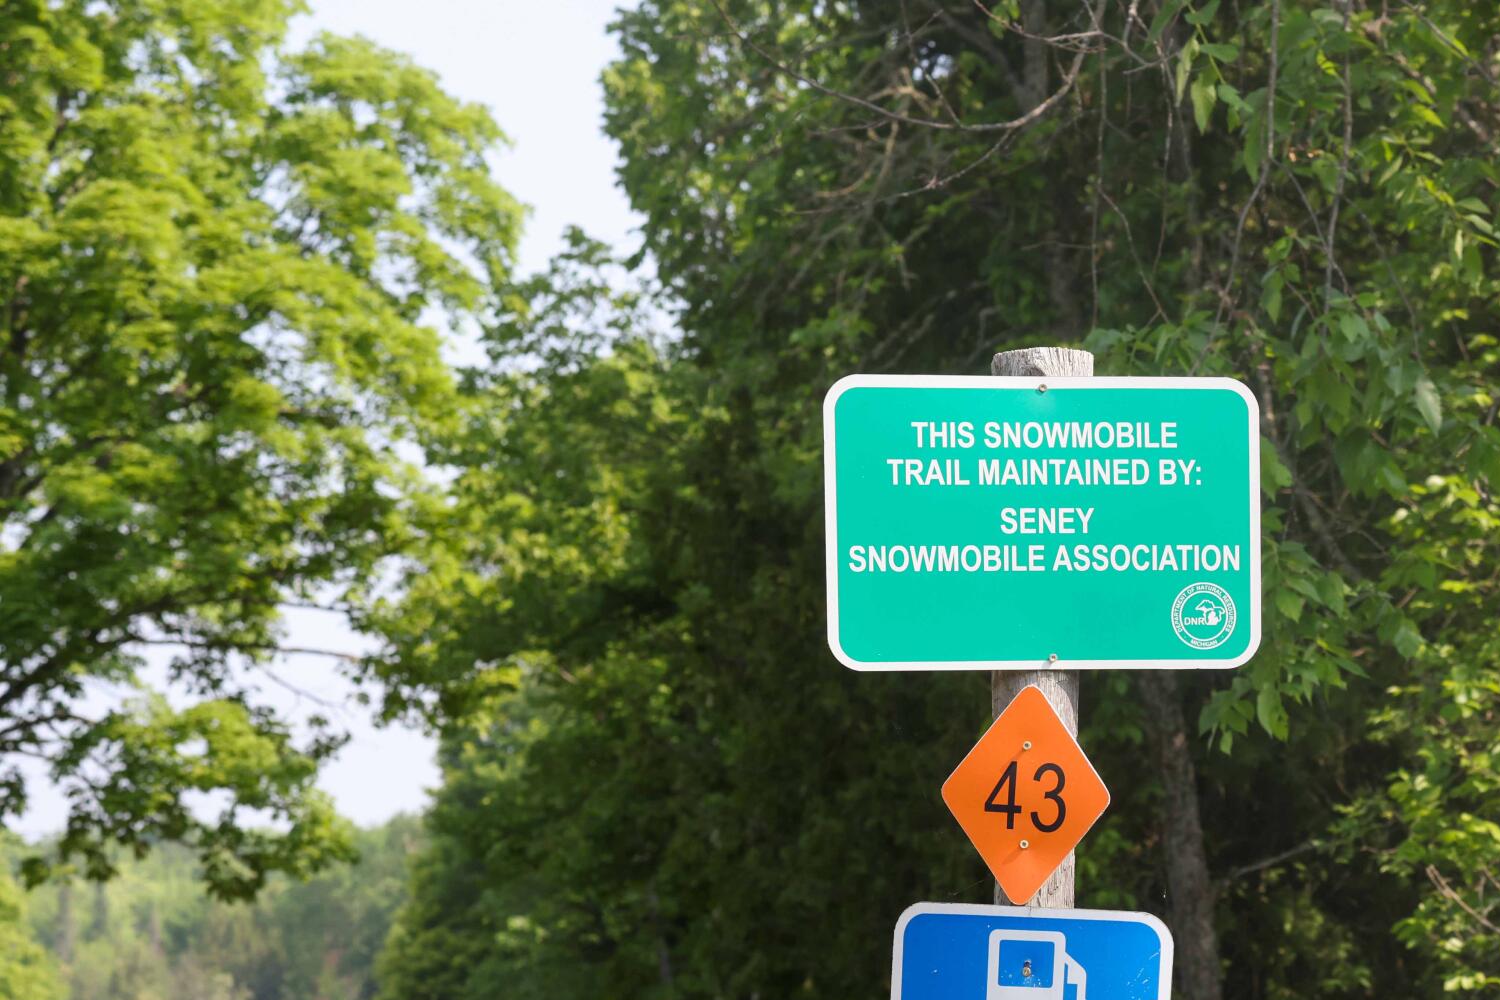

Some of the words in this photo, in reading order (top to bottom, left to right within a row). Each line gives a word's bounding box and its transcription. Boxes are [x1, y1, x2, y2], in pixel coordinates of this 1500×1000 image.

[911, 421, 975, 448] THIS
[984, 421, 1178, 449] SNOWMOBILE
[887, 459, 970, 486] TRAIL
[978, 459, 1150, 486] MAINTAINED
[1158, 459, 1202, 486] BY:
[1000, 507, 1095, 534] SENEY
[848, 545, 1045, 572] SNOWMOBILE
[1053, 544, 1241, 571] ASSOCIATION
[1196, 584, 1223, 598] NATURAL
[1184, 617, 1205, 626] DNR
[984, 760, 1067, 833] 43
